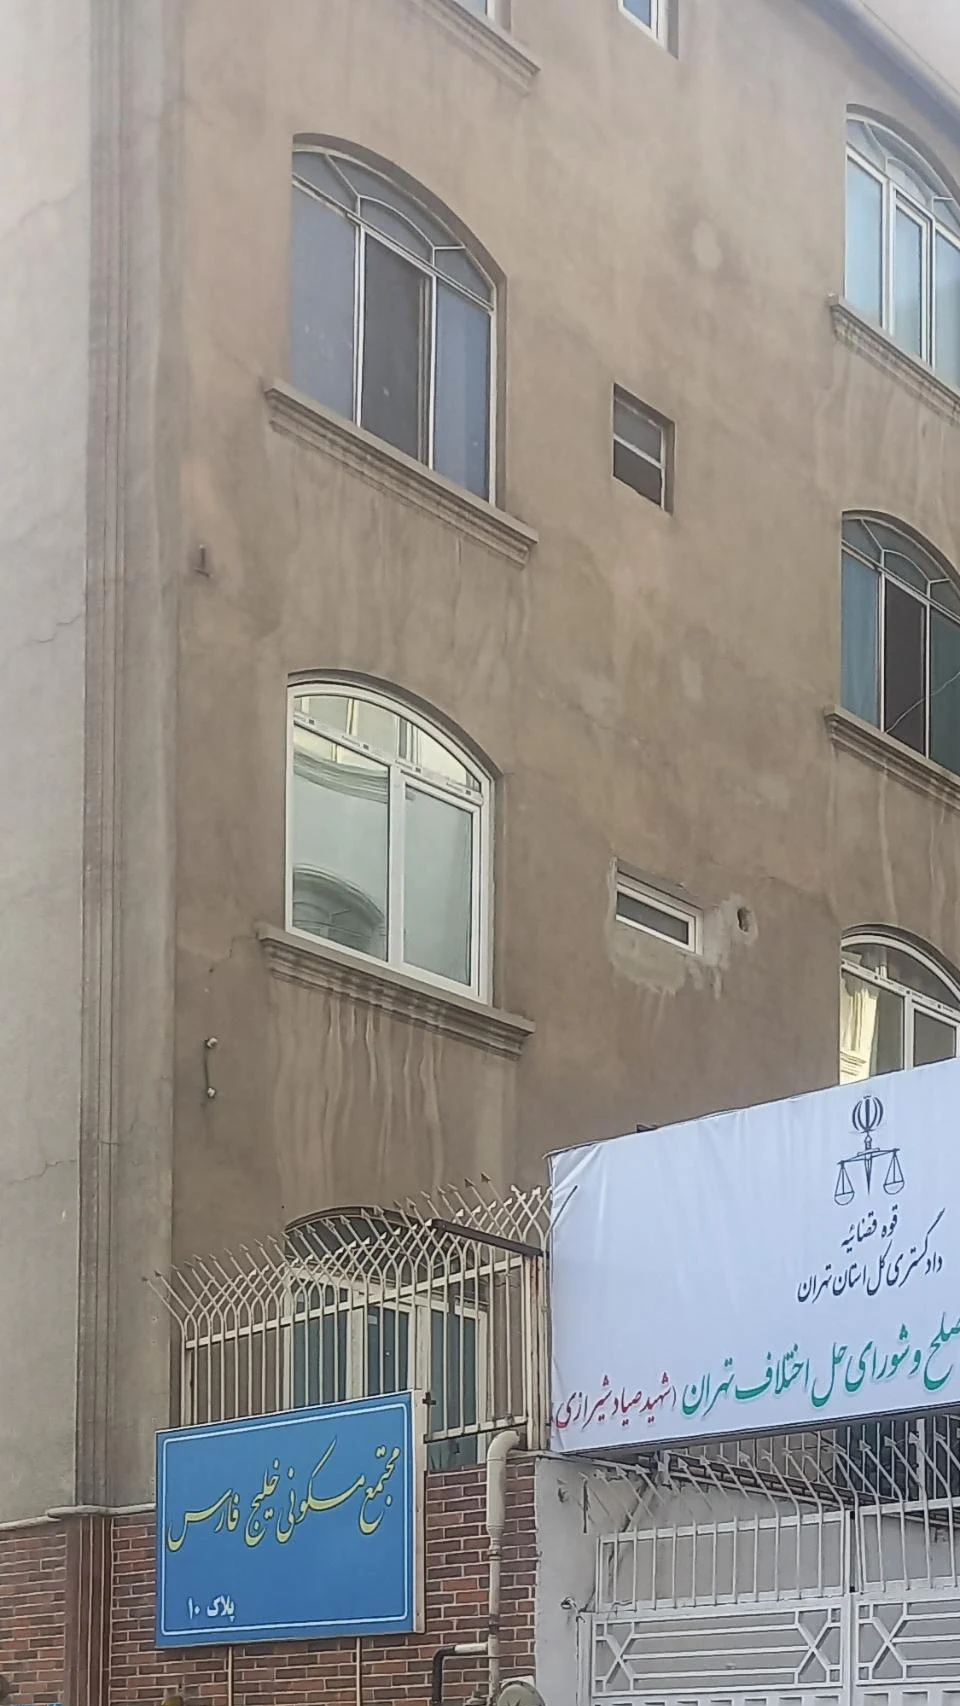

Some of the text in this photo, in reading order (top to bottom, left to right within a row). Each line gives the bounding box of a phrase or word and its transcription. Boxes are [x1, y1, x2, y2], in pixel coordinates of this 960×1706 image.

[881, 1204, 898, 1238] قوه
[797, 1207, 945, 1304] دادگستری کل استان تهران
[682, 1356, 736, 1417] تهران
[735, 1342, 809, 1401] اختلاف
[811, 1342, 849, 1408] حل
[845, 1322, 909, 1393] شورای
[909, 1348, 922, 1376] و
[612, 1386, 643, 1427] صیاد
[167, 1432, 401, 1552] مجتمع مسکونی خلیج فارس
[187, 1594, 236, 1622] پلاک ۱۰
